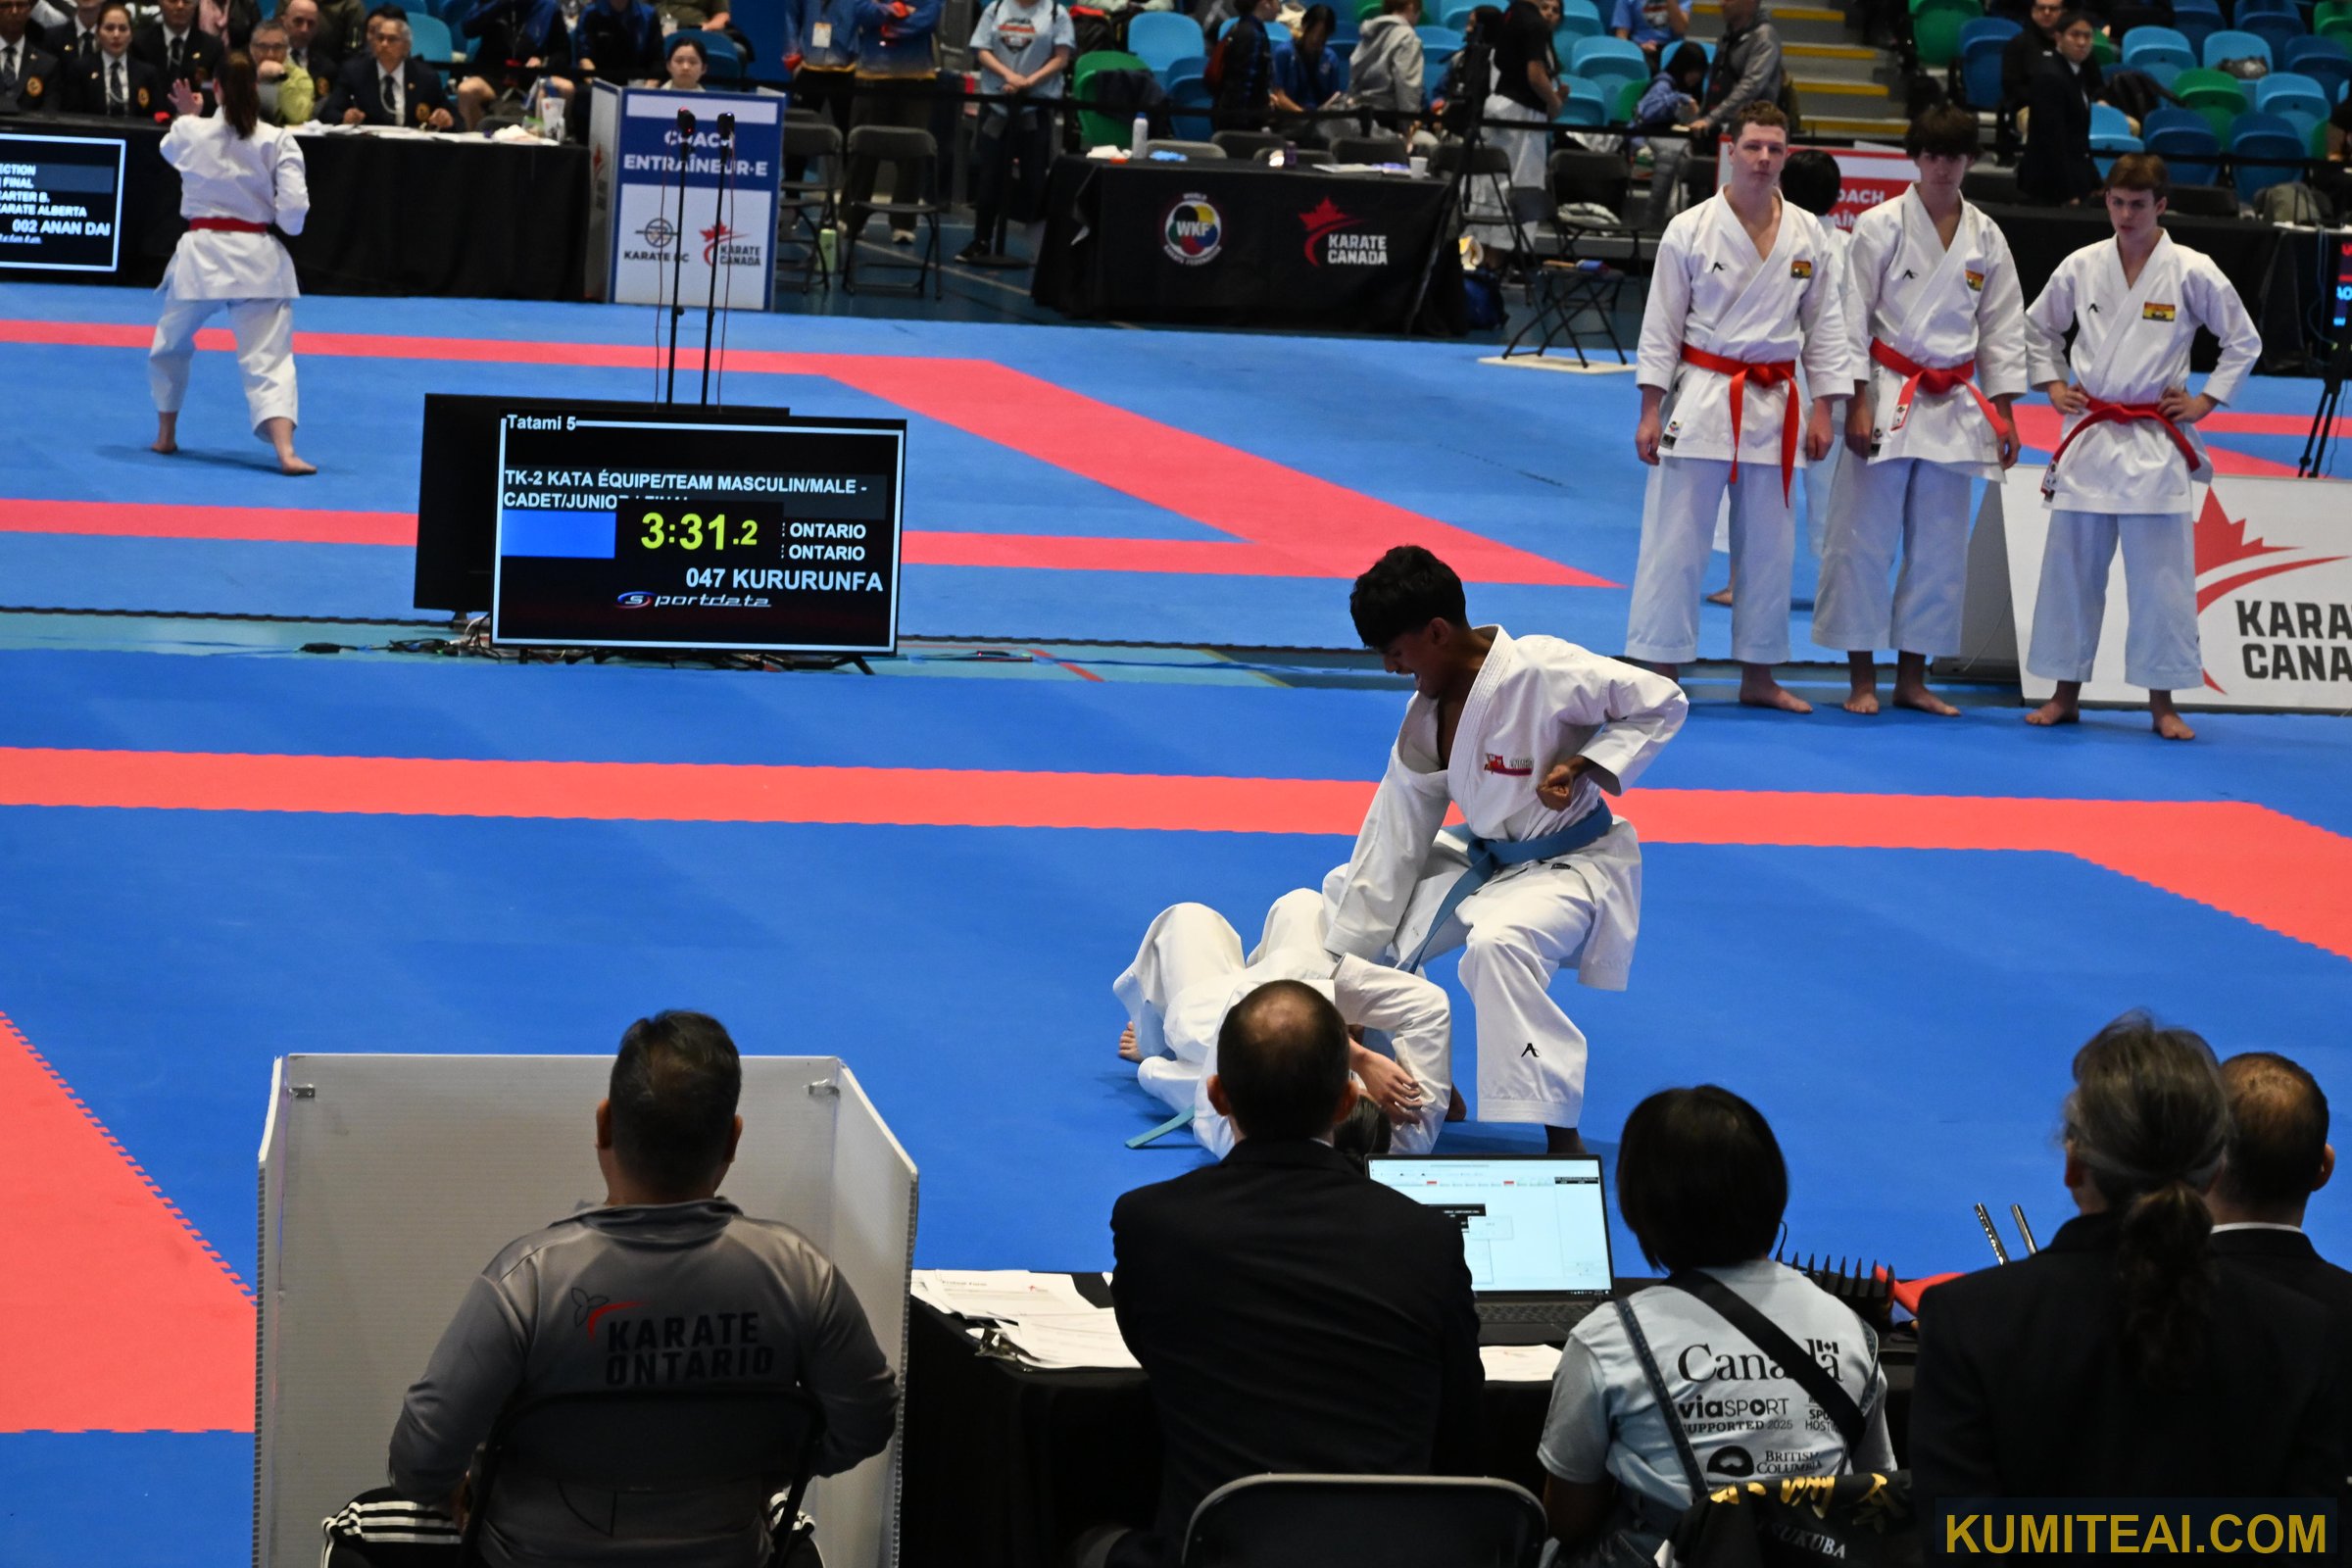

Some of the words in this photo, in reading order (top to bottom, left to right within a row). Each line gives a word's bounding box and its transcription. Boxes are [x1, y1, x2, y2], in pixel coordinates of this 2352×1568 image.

[0, 190, 37, 202] ARTER
[0, 203, 36, 215] ARATE
[37, 205, 87, 217] ALBERTA
[12, 219, 38, 233] 002
[40, 220, 82, 235] ANAN
[85, 221, 111, 236] DAI
[1176, 220, 1210, 236] WKF
[1328, 234, 1387, 250] KARATE
[623, 250, 670, 262] KARATE
[719, 245, 761, 256] KARATE
[1327, 249, 1388, 265] CANADA
[719, 255, 761, 267] CANADA
[507, 415, 562, 430] Tatami
[566, 416, 576, 431] 5
[505, 469, 542, 486] TK-2
[548, 471, 593, 487] KATA
[598, 468, 712, 490] ÉQUIPE/TEAM
[718, 475, 857, 494] MASCULIN/MALE
[504, 492, 629, 510] CADET/JUNIO
[789, 522, 866, 539] ONTARIO
[788, 545, 865, 562] ONTARIO
[686, 567, 725, 588] 047
[732, 568, 883, 592] KURURUNFA
[2235, 600, 2352, 640] KARA
[608, 1311, 760, 1352] KARATE
[606, 1346, 774, 1386] ONTARIO
[1678, 1339, 1843, 1383] Canaa
[1684, 1420, 1764, 1434] UPPORTED
[1767, 1419, 1793, 1430] 2025
